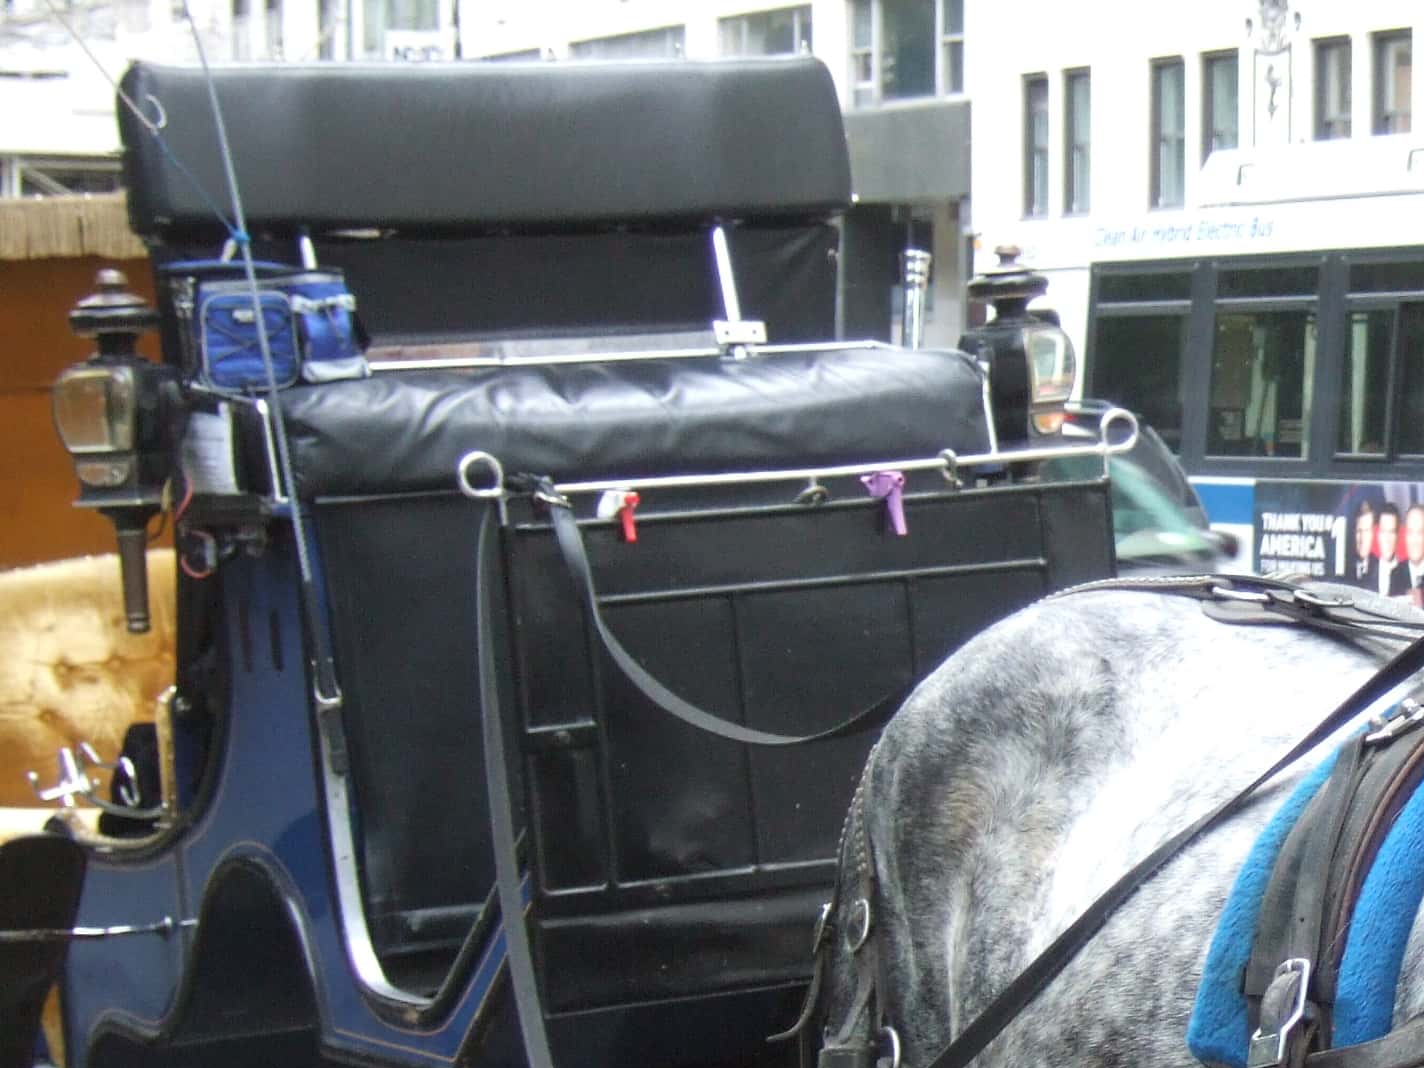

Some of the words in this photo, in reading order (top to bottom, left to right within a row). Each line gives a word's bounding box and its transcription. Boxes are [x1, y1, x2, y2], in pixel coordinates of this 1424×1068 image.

[1249, 216, 1275, 239] Bus
[1261, 512, 1301, 532] THANK
[1302, 513, 1325, 533] YOU
[1259, 533, 1326, 560] AMERICA
